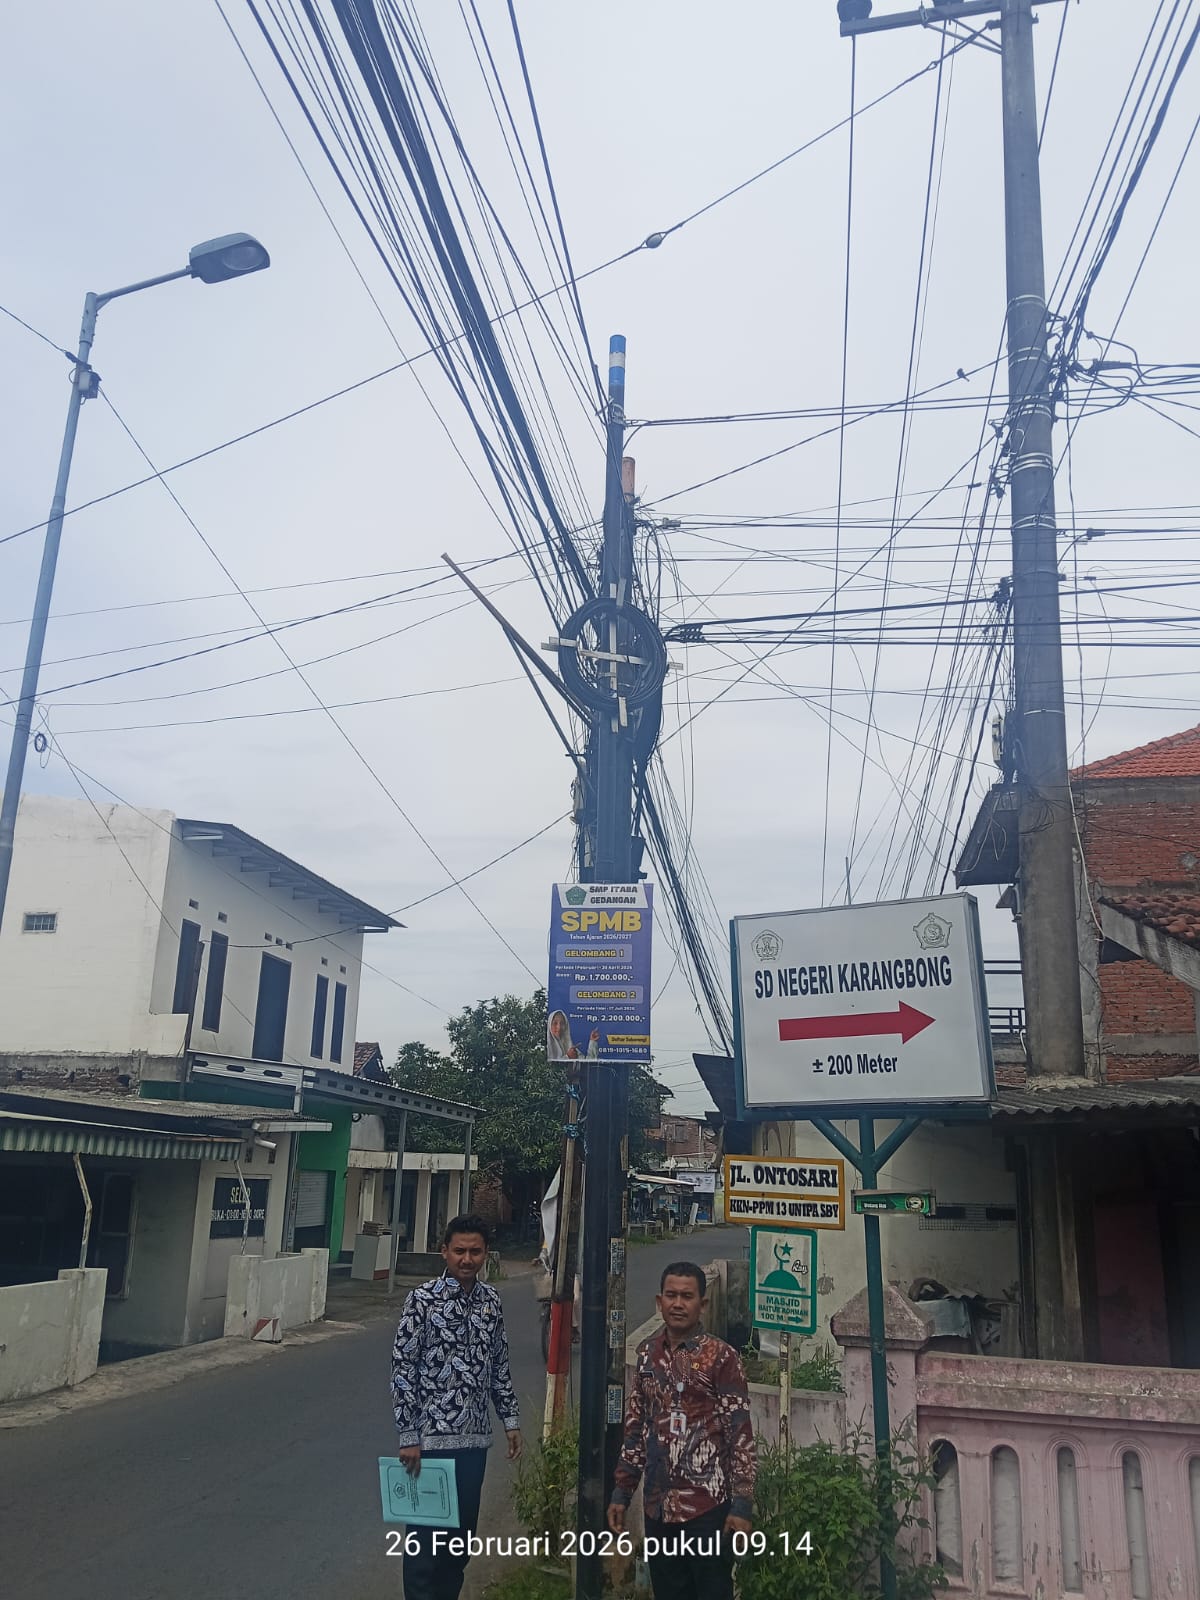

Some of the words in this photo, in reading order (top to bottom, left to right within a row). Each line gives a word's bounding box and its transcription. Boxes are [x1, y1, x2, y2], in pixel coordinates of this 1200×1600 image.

[590, 896, 636, 904] GEDANGAN
[561, 910, 642, 932] SPMB
[565, 949, 617, 957] GELOMBANG
[619, 949, 624, 957] 1
[754, 969, 773, 998] SD
[777, 964, 834, 997] NEGERI
[837, 955, 952, 992] KARANGBONG
[577, 991, 627, 999] GELOMBANG
[827, 1055, 853, 1076] 200
[857, 1053, 898, 1075] Meter
[730, 1165, 751, 1187] JL.
[753, 1166, 838, 1188] ONTOSARI
[730, 1198, 774, 1215] KKN-PPM
[776, 1202, 787, 1216] 13
[788, 1203, 820, 1217] UNIPA
[820, 1204, 839, 1218] SBY
[766, 1295, 800, 1307] MASJID
[760, 1312, 775, 1320] 100
[781, 1307, 808, 1316] ROHMAN
